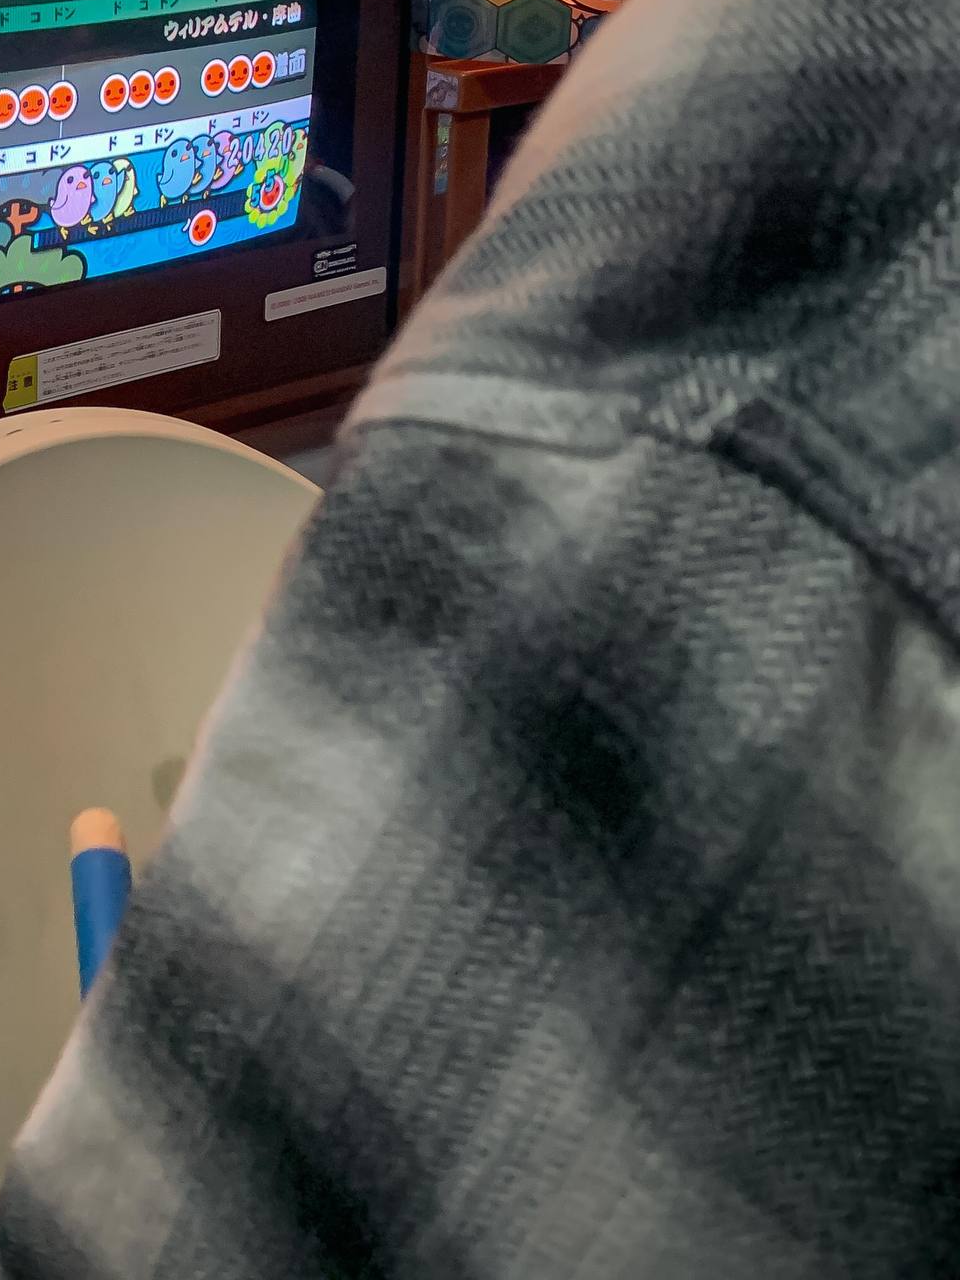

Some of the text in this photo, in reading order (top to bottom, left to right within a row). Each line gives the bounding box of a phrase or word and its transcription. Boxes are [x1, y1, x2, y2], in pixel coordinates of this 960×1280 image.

[163, 1, 303, 42] ウィリアムテル・序曲
[227, 126, 294, 168] 20420
